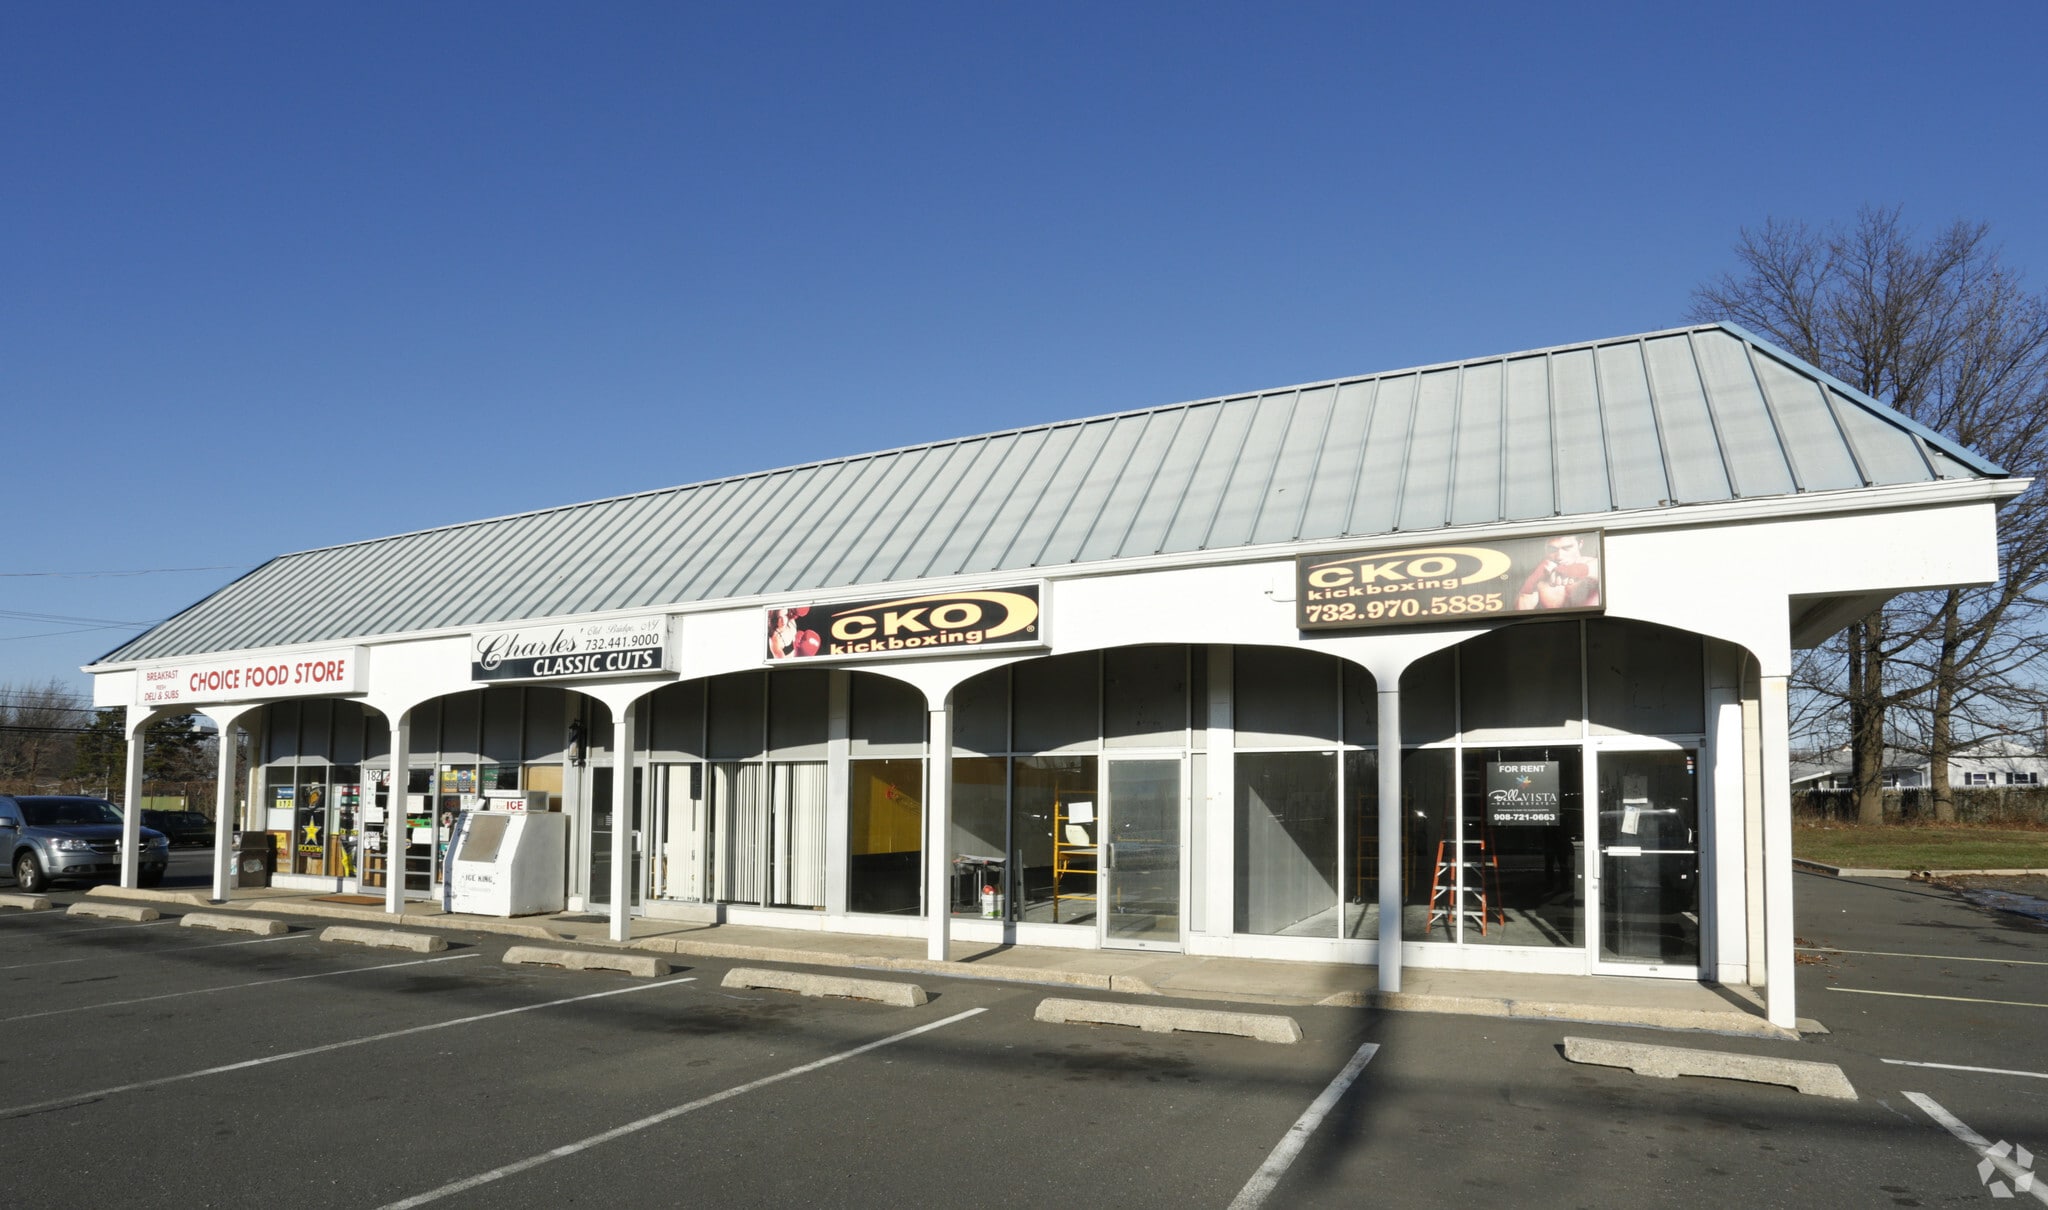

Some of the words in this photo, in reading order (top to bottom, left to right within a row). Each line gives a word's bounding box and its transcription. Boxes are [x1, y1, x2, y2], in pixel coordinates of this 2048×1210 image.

[1308, 556, 1457, 588] CKO
[1308, 577, 1459, 601] kickboxing
[1306, 593, 1503, 623] 732.970.5885
[830, 602, 983, 641] CKO
[585, 633, 659, 651] 732.441.9000
[829, 629, 983, 656] kickboxing
[146, 669, 179, 681] BREAKFAST
[533, 656, 601, 676] CLASSIC
[605, 650, 654, 671] CUTS
[189, 669, 240, 692] CHOICE
[245, 664, 290, 688] FOOD
[294, 659, 346, 684] STORE
[144, 691, 157, 701] DELI
[157, 691, 163, 700] &
[164, 689, 180, 700] SUBS
[367, 770, 382, 782] 182
[1498, 765, 1519, 773] FOR
[1520, 764, 1546, 773] RENT
[506, 800, 524, 811] ICE
